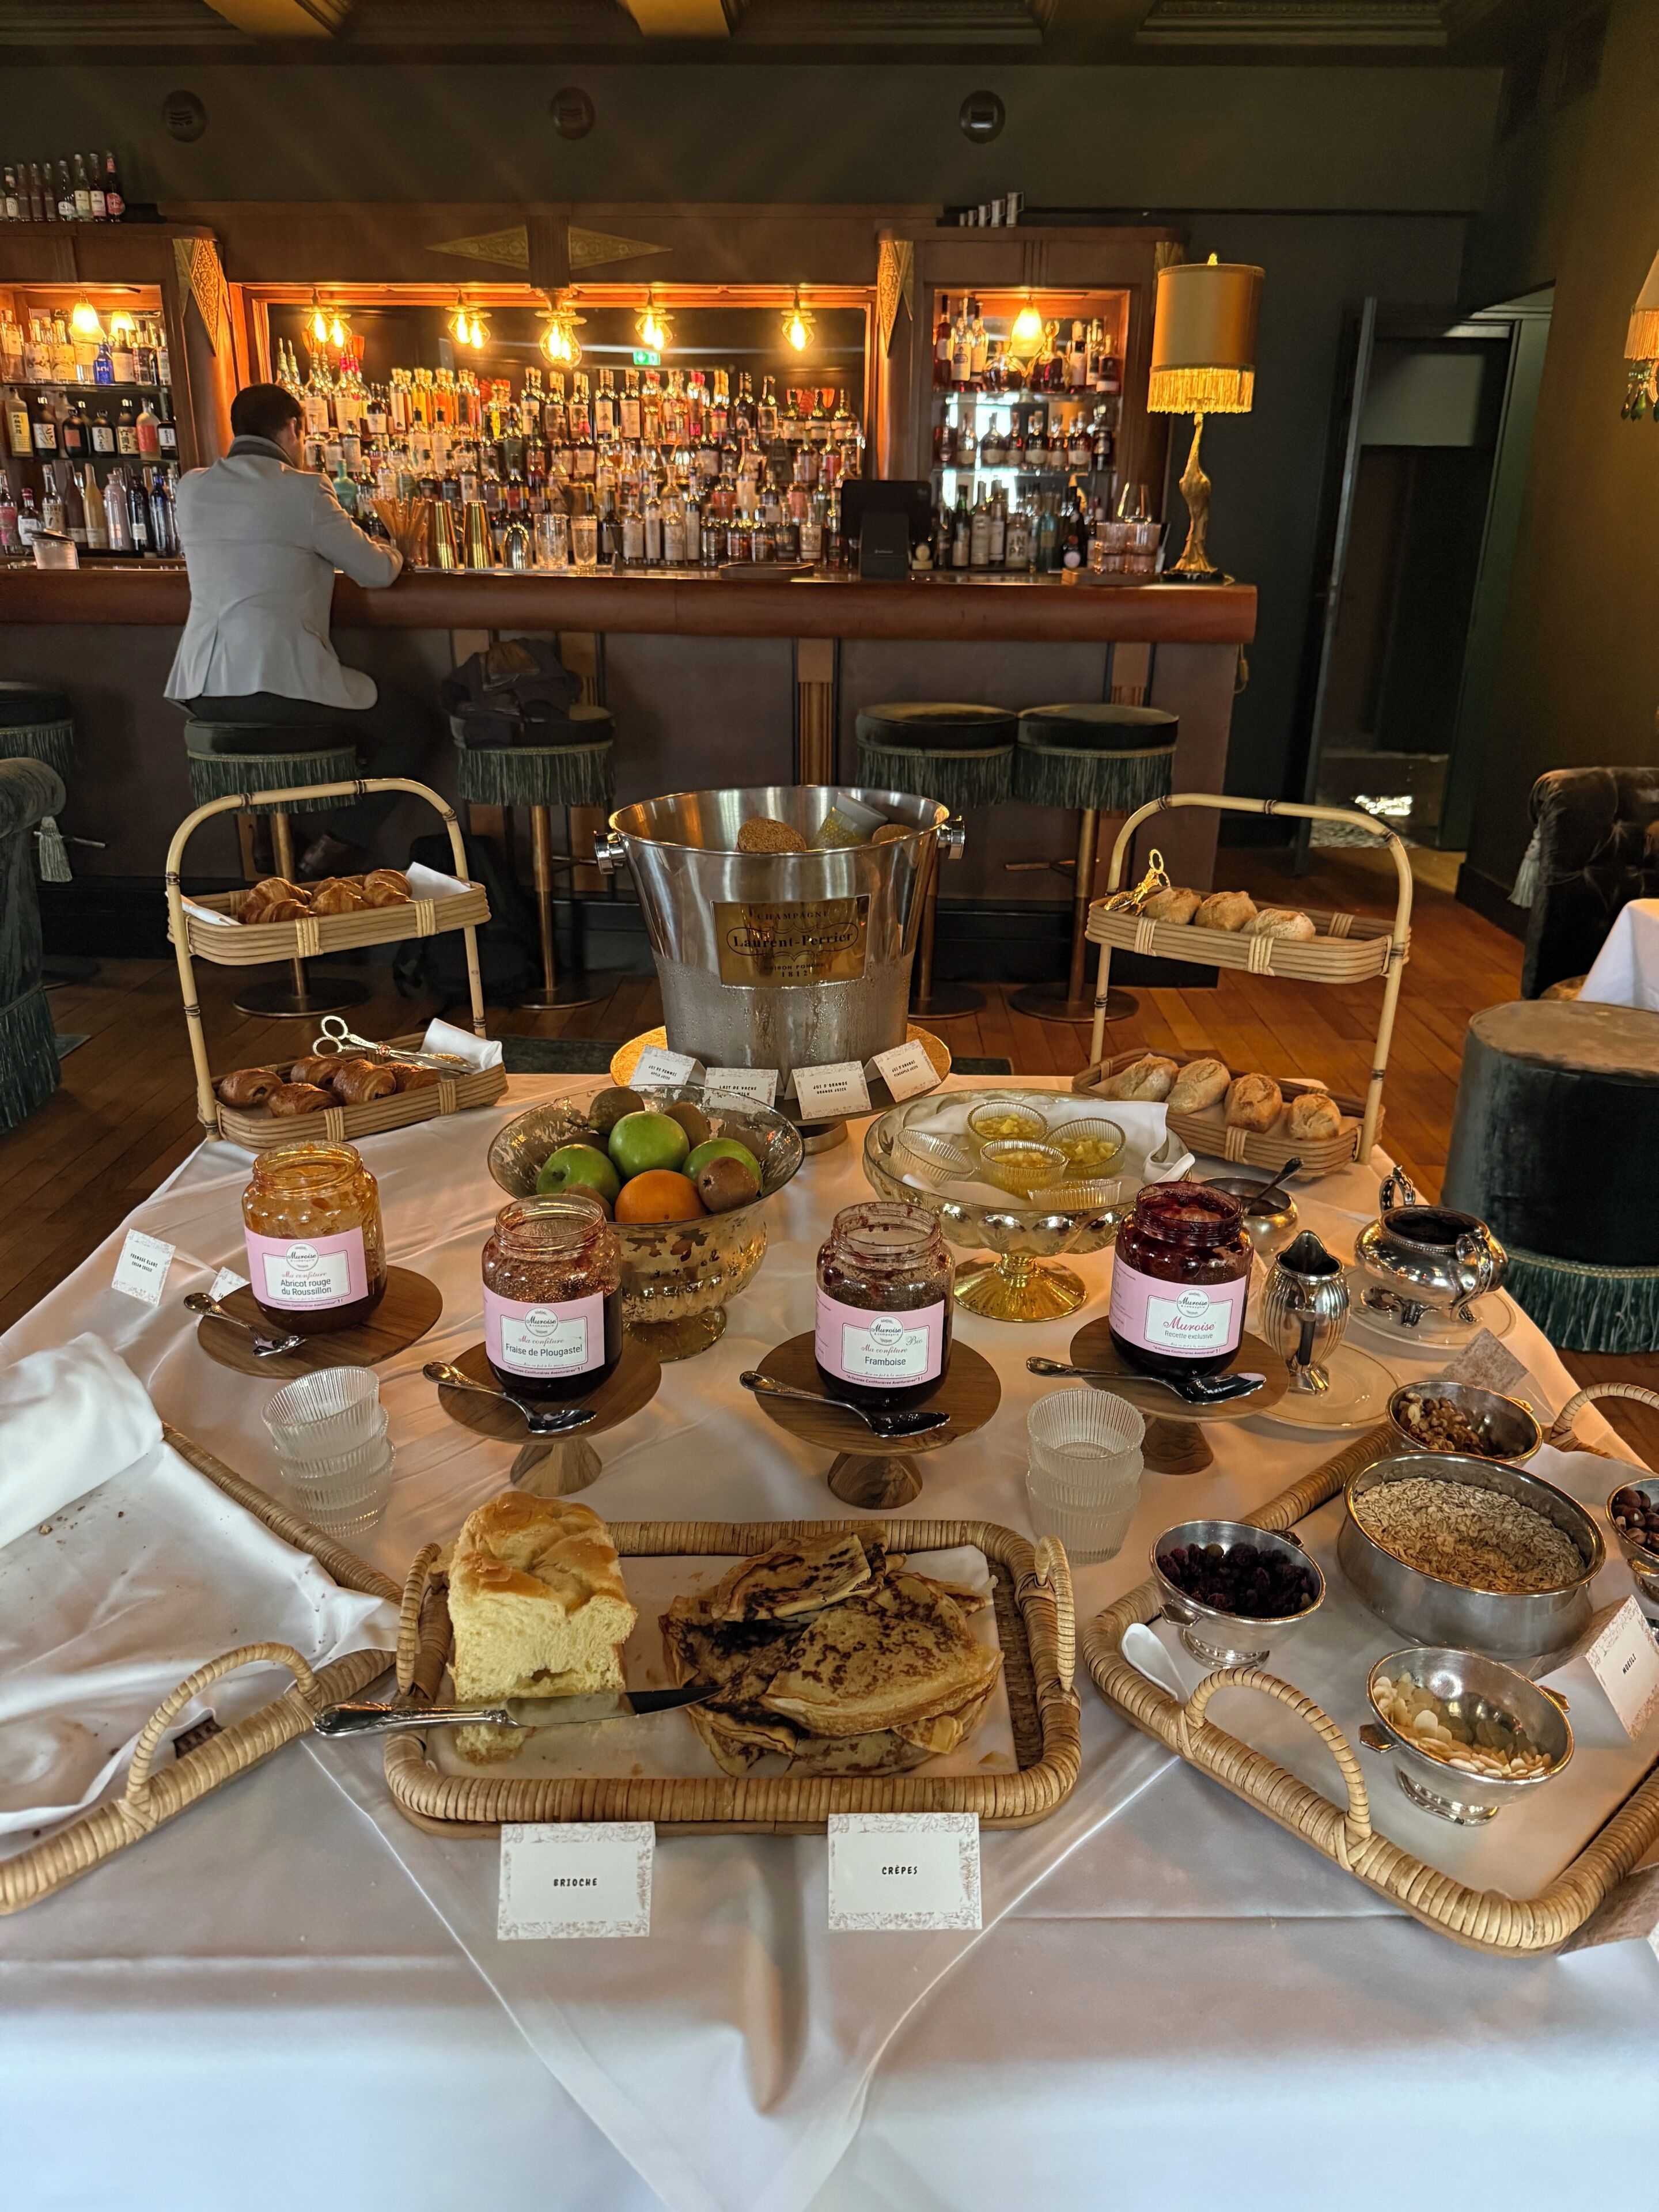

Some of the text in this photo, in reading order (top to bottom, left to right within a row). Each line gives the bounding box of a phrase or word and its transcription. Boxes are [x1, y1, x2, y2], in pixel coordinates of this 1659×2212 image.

[733, 931, 853, 949] Laurent-Perrier
[281, 1278, 331, 1288] Abricot rouge
[282, 1286, 332, 1296] du Roussillon
[871, 1324, 902, 1333] Muroise
[1163, 1316, 1215, 1331] Muroise
[1165, 1330, 1187, 1339] Recette
[906, 1335, 923, 1346] Bio
[506, 1343, 582, 1357] Fraise de Plougastel
[861, 1343, 874, 1353] Ma
[865, 1356, 906, 1366] Framboise
[882, 1864, 918, 1875] CRÊPES
[554, 1878, 597, 1887] BRIOCHE
